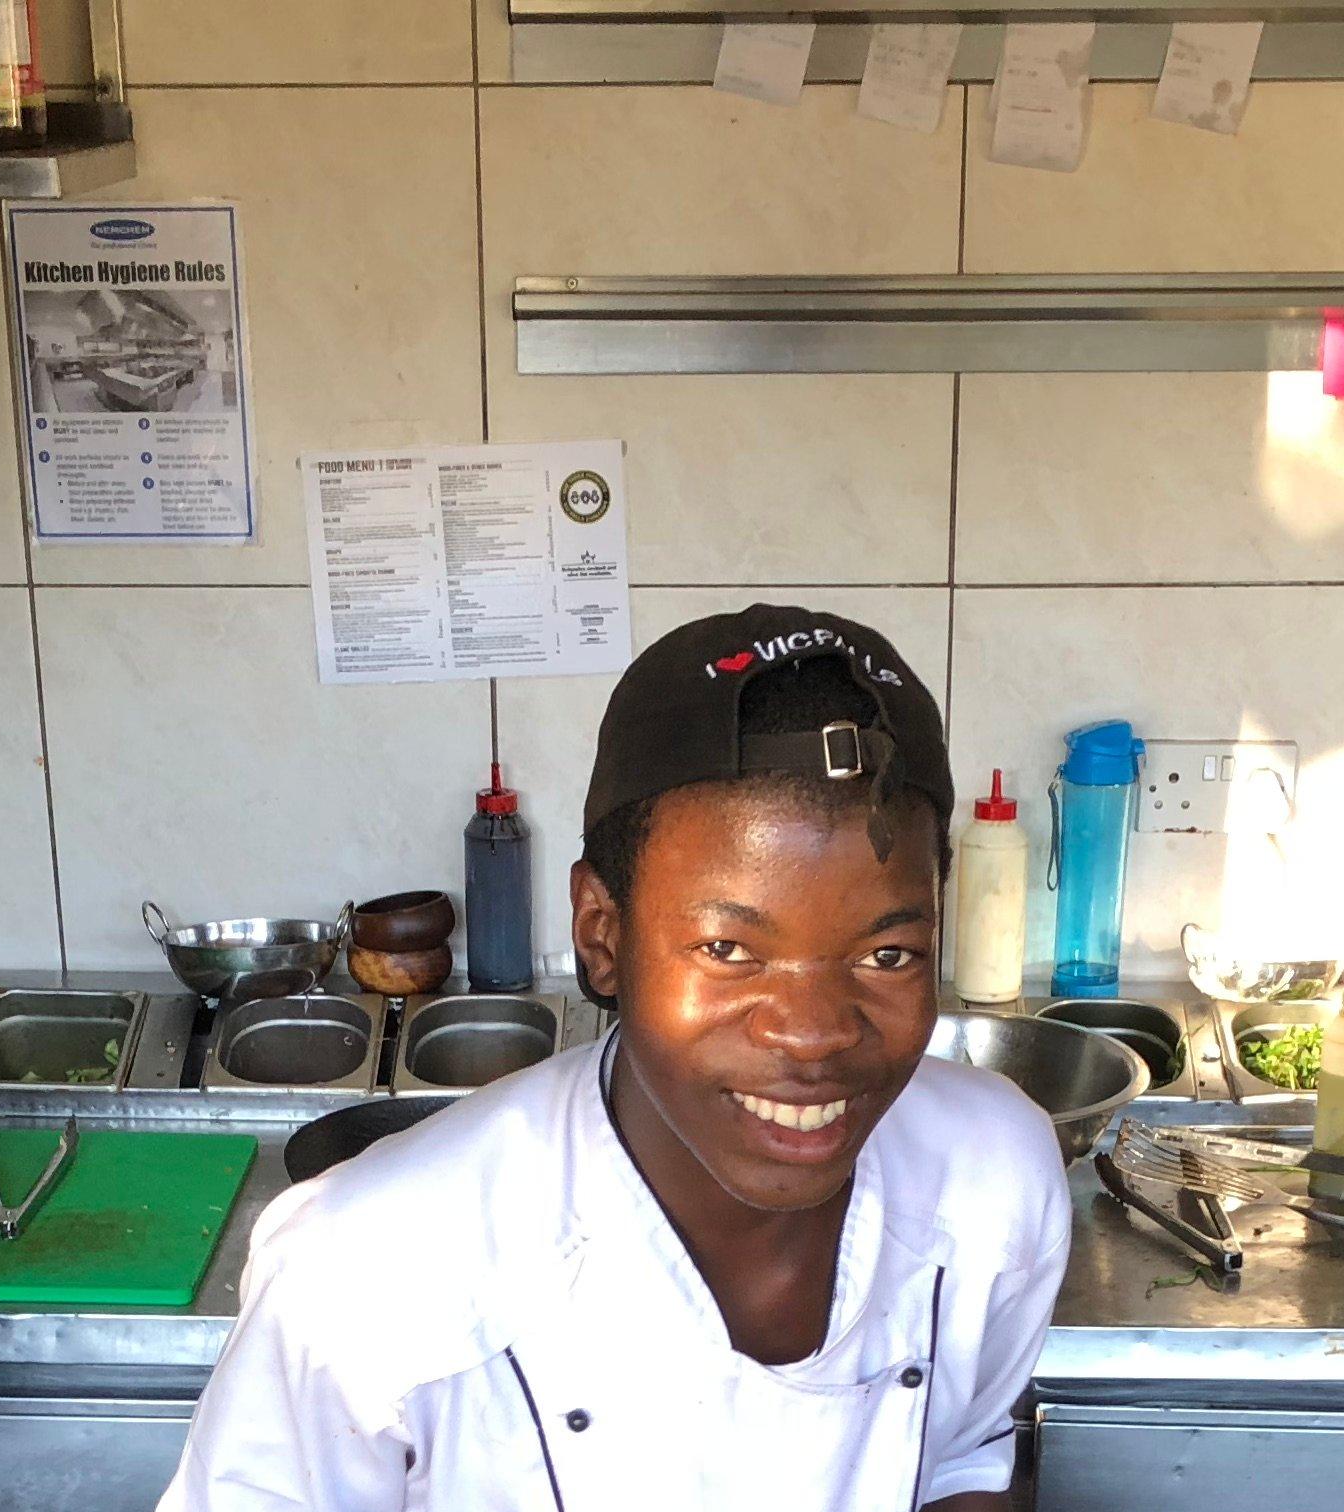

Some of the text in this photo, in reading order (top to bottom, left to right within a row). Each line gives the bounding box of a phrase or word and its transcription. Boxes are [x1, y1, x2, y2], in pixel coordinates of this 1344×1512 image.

[24, 260, 226, 285] Kitchen Hygiene Rules
[317, 460, 344, 474] FOOD
[346, 458, 375, 473] MENU
[706, 662, 718, 679] I
